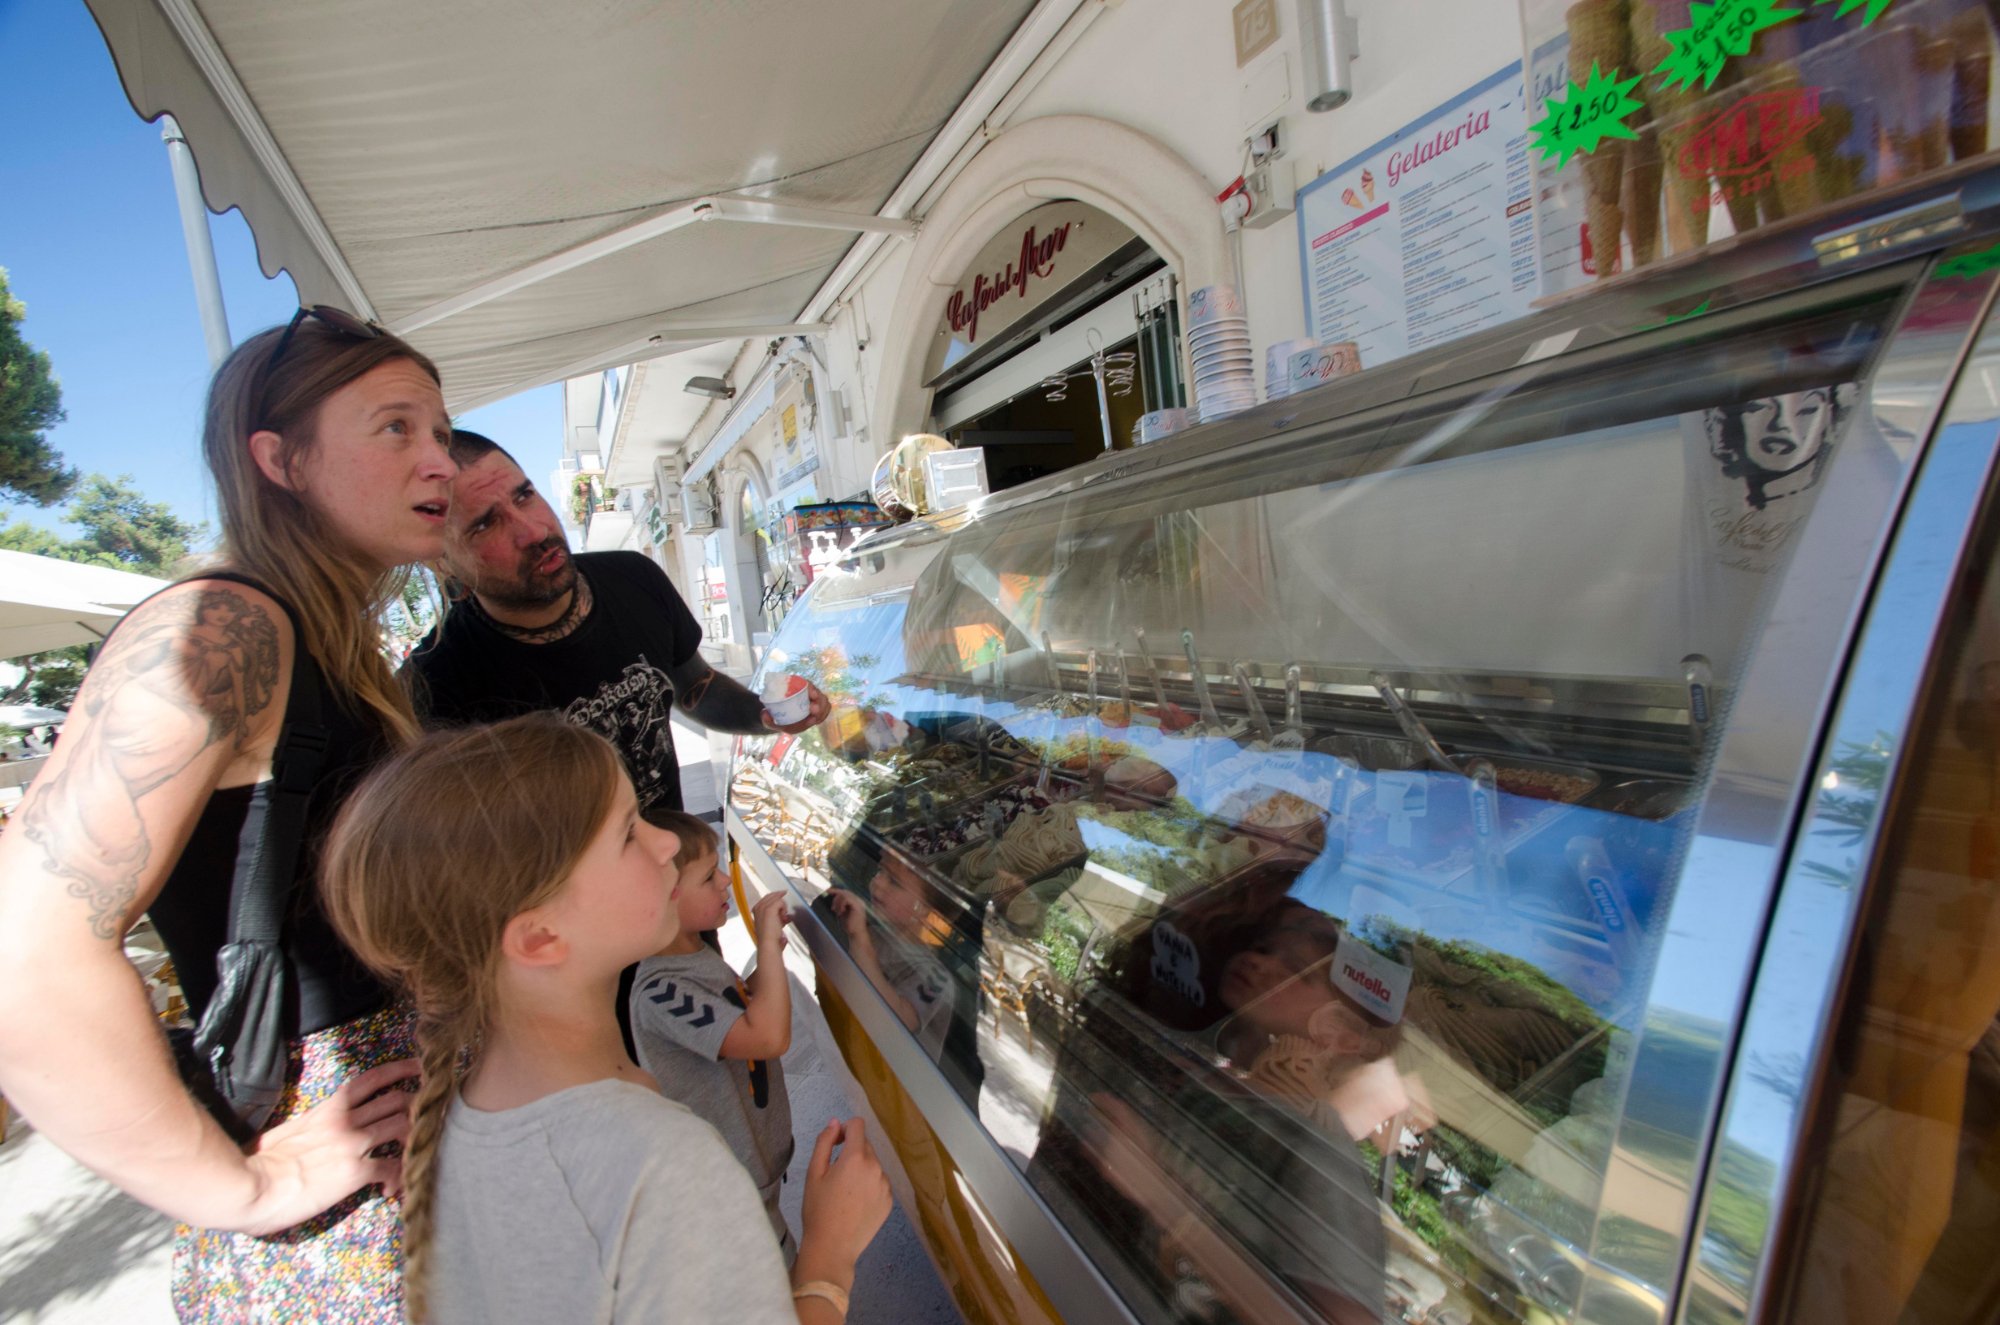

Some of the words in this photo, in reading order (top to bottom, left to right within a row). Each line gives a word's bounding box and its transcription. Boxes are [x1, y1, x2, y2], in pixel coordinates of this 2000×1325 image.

[1240, 1, 1267, 45] 75
[1386, 109, 1490, 188] Gelateria
[1593, 882, 1621, 928] elenka
[1342, 961, 1392, 1004] nutella
